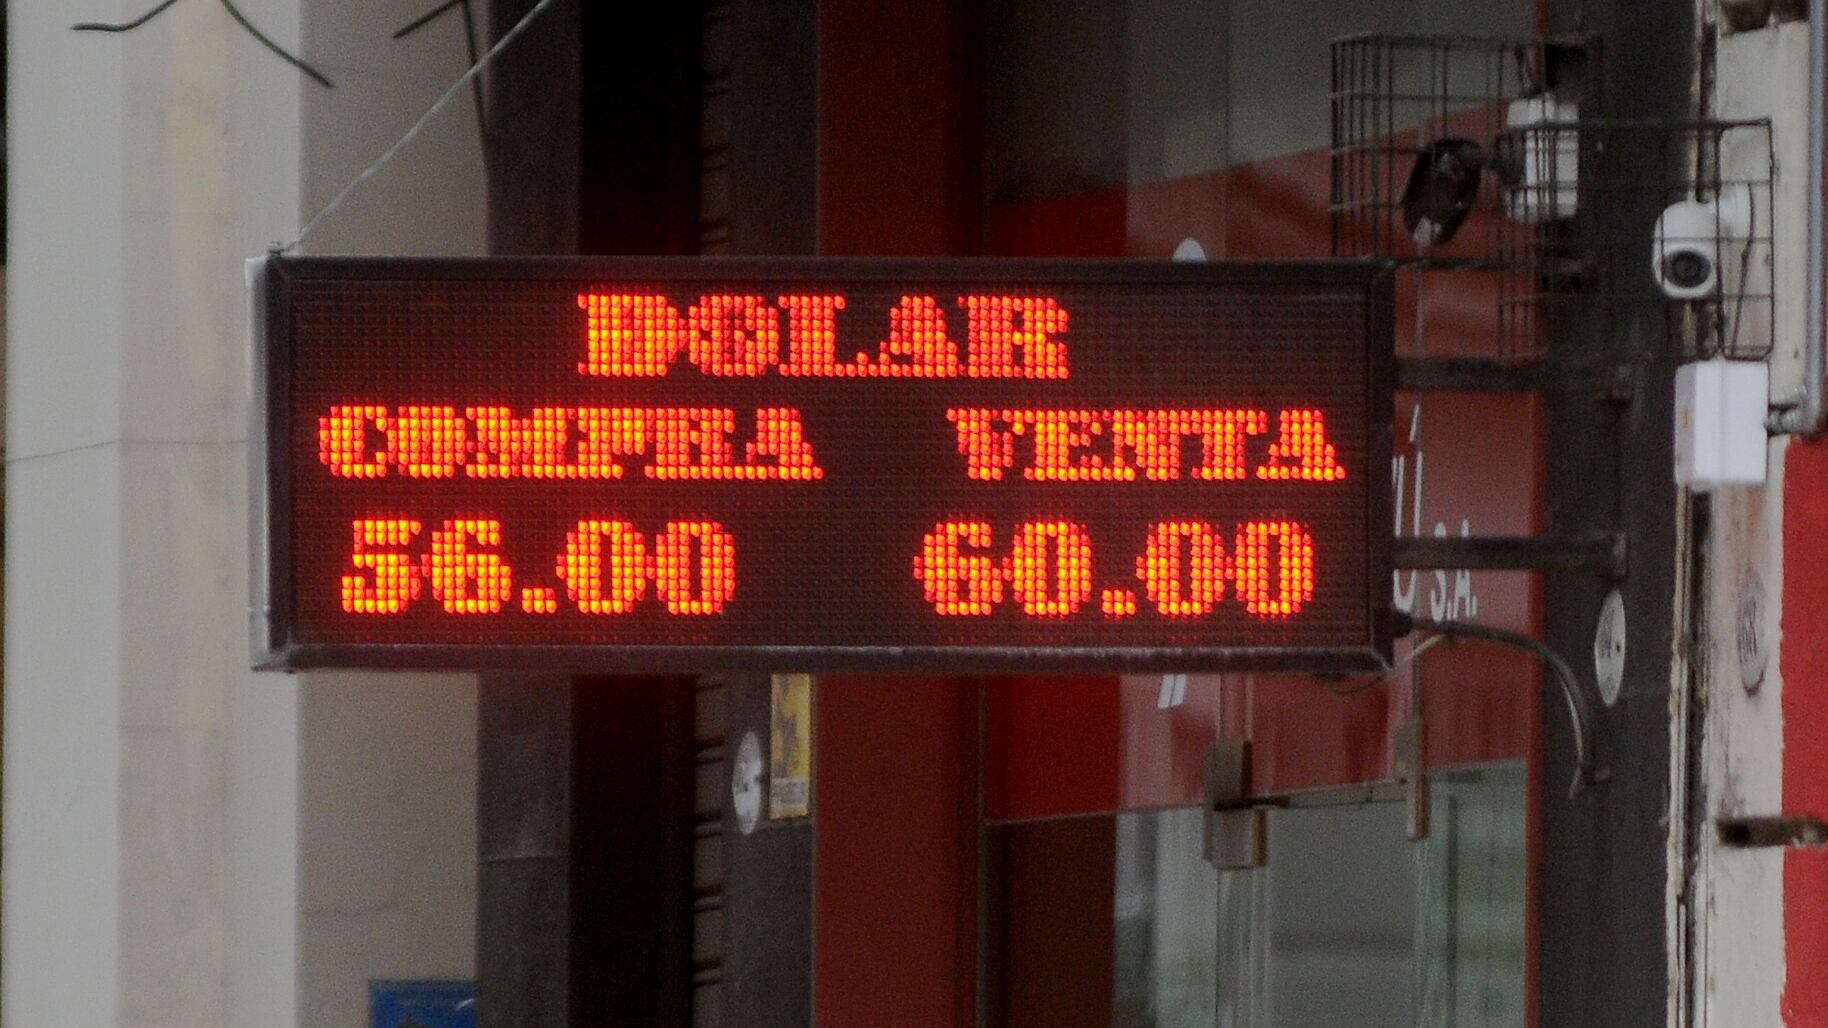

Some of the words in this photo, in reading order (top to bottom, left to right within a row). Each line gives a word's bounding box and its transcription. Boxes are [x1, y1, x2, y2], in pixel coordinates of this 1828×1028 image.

[578, 293, 1069, 378] DOLAR
[319, 405, 824, 480] COMPRA
[947, 408, 1346, 481] VENTA
[342, 516, 735, 615] 56.00
[914, 520, 1314, 618] 60.00
